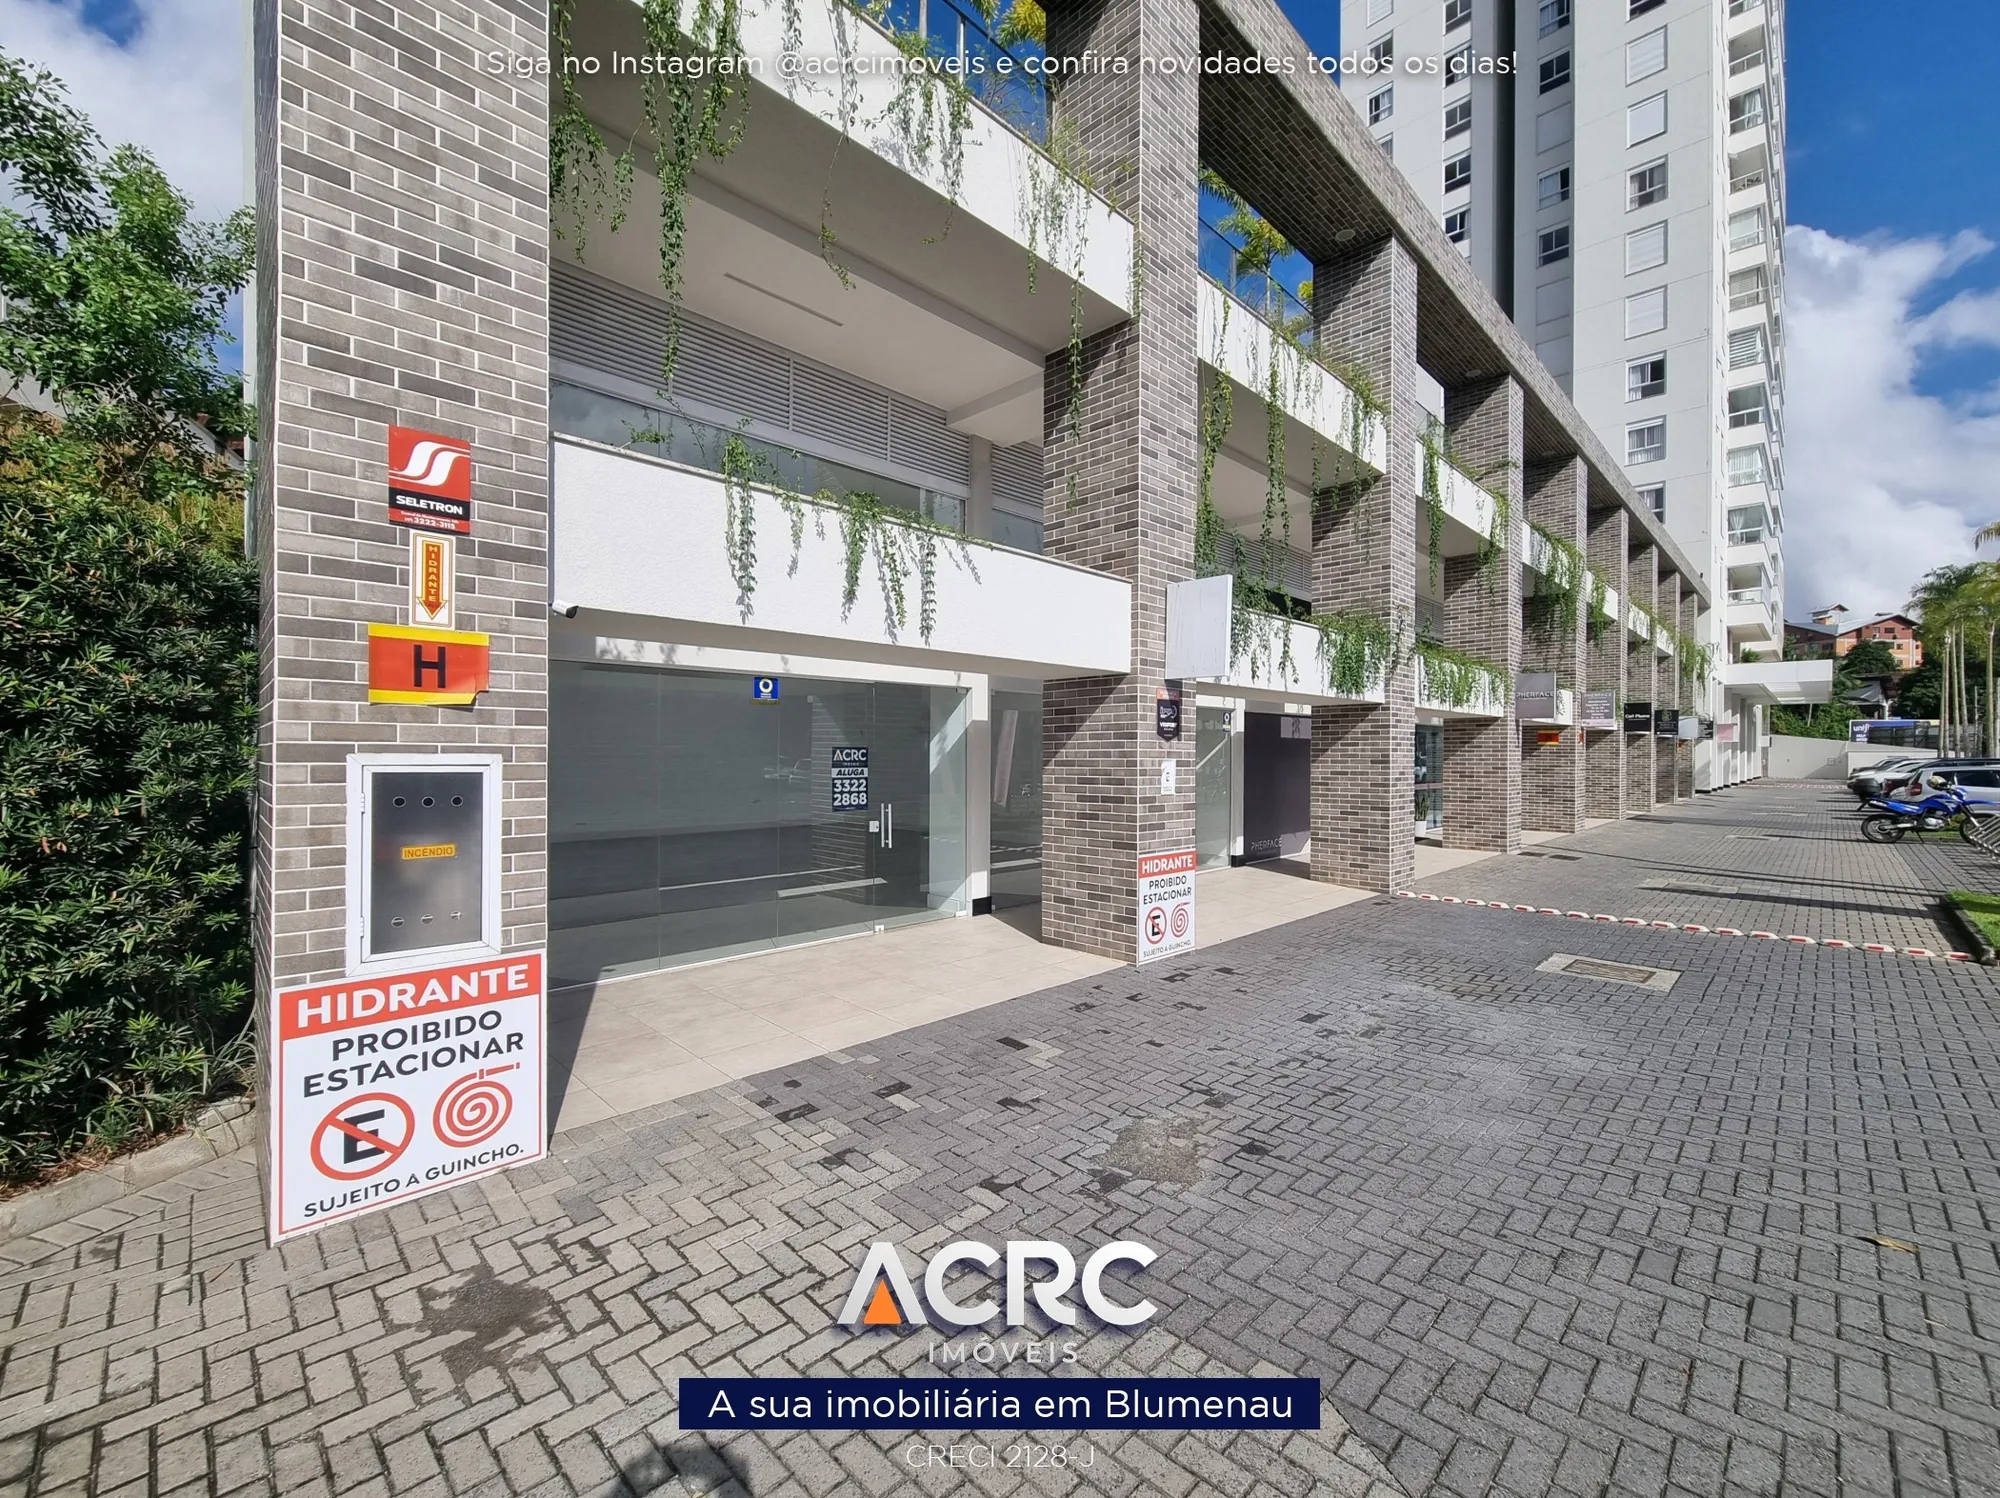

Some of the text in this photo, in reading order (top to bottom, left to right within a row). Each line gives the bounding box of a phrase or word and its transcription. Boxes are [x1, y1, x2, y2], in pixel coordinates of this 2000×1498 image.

[396, 494, 463, 515] SELETRON
[428, 545, 438, 602] HIDRANTE
[413, 644, 446, 689] H
[833, 749, 867, 761] ACRC
[833, 779, 867, 792] 3322
[833, 793, 867, 806] 2868
[1142, 854, 1193, 874] HIDRANTE
[1149, 875, 1187, 890] PROIBIDO
[1143, 887, 1192, 905] ESTACIONAR
[1143, 946, 1164, 957] SUJEITO
[297, 963, 529, 1029] HIDRANTE
[332, 1009, 502, 1062] PROIBIDO
[303, 1032, 524, 1098] ESTACIONAR
[303, 1143, 524, 1217] SUJEITO A GUINCHO.
